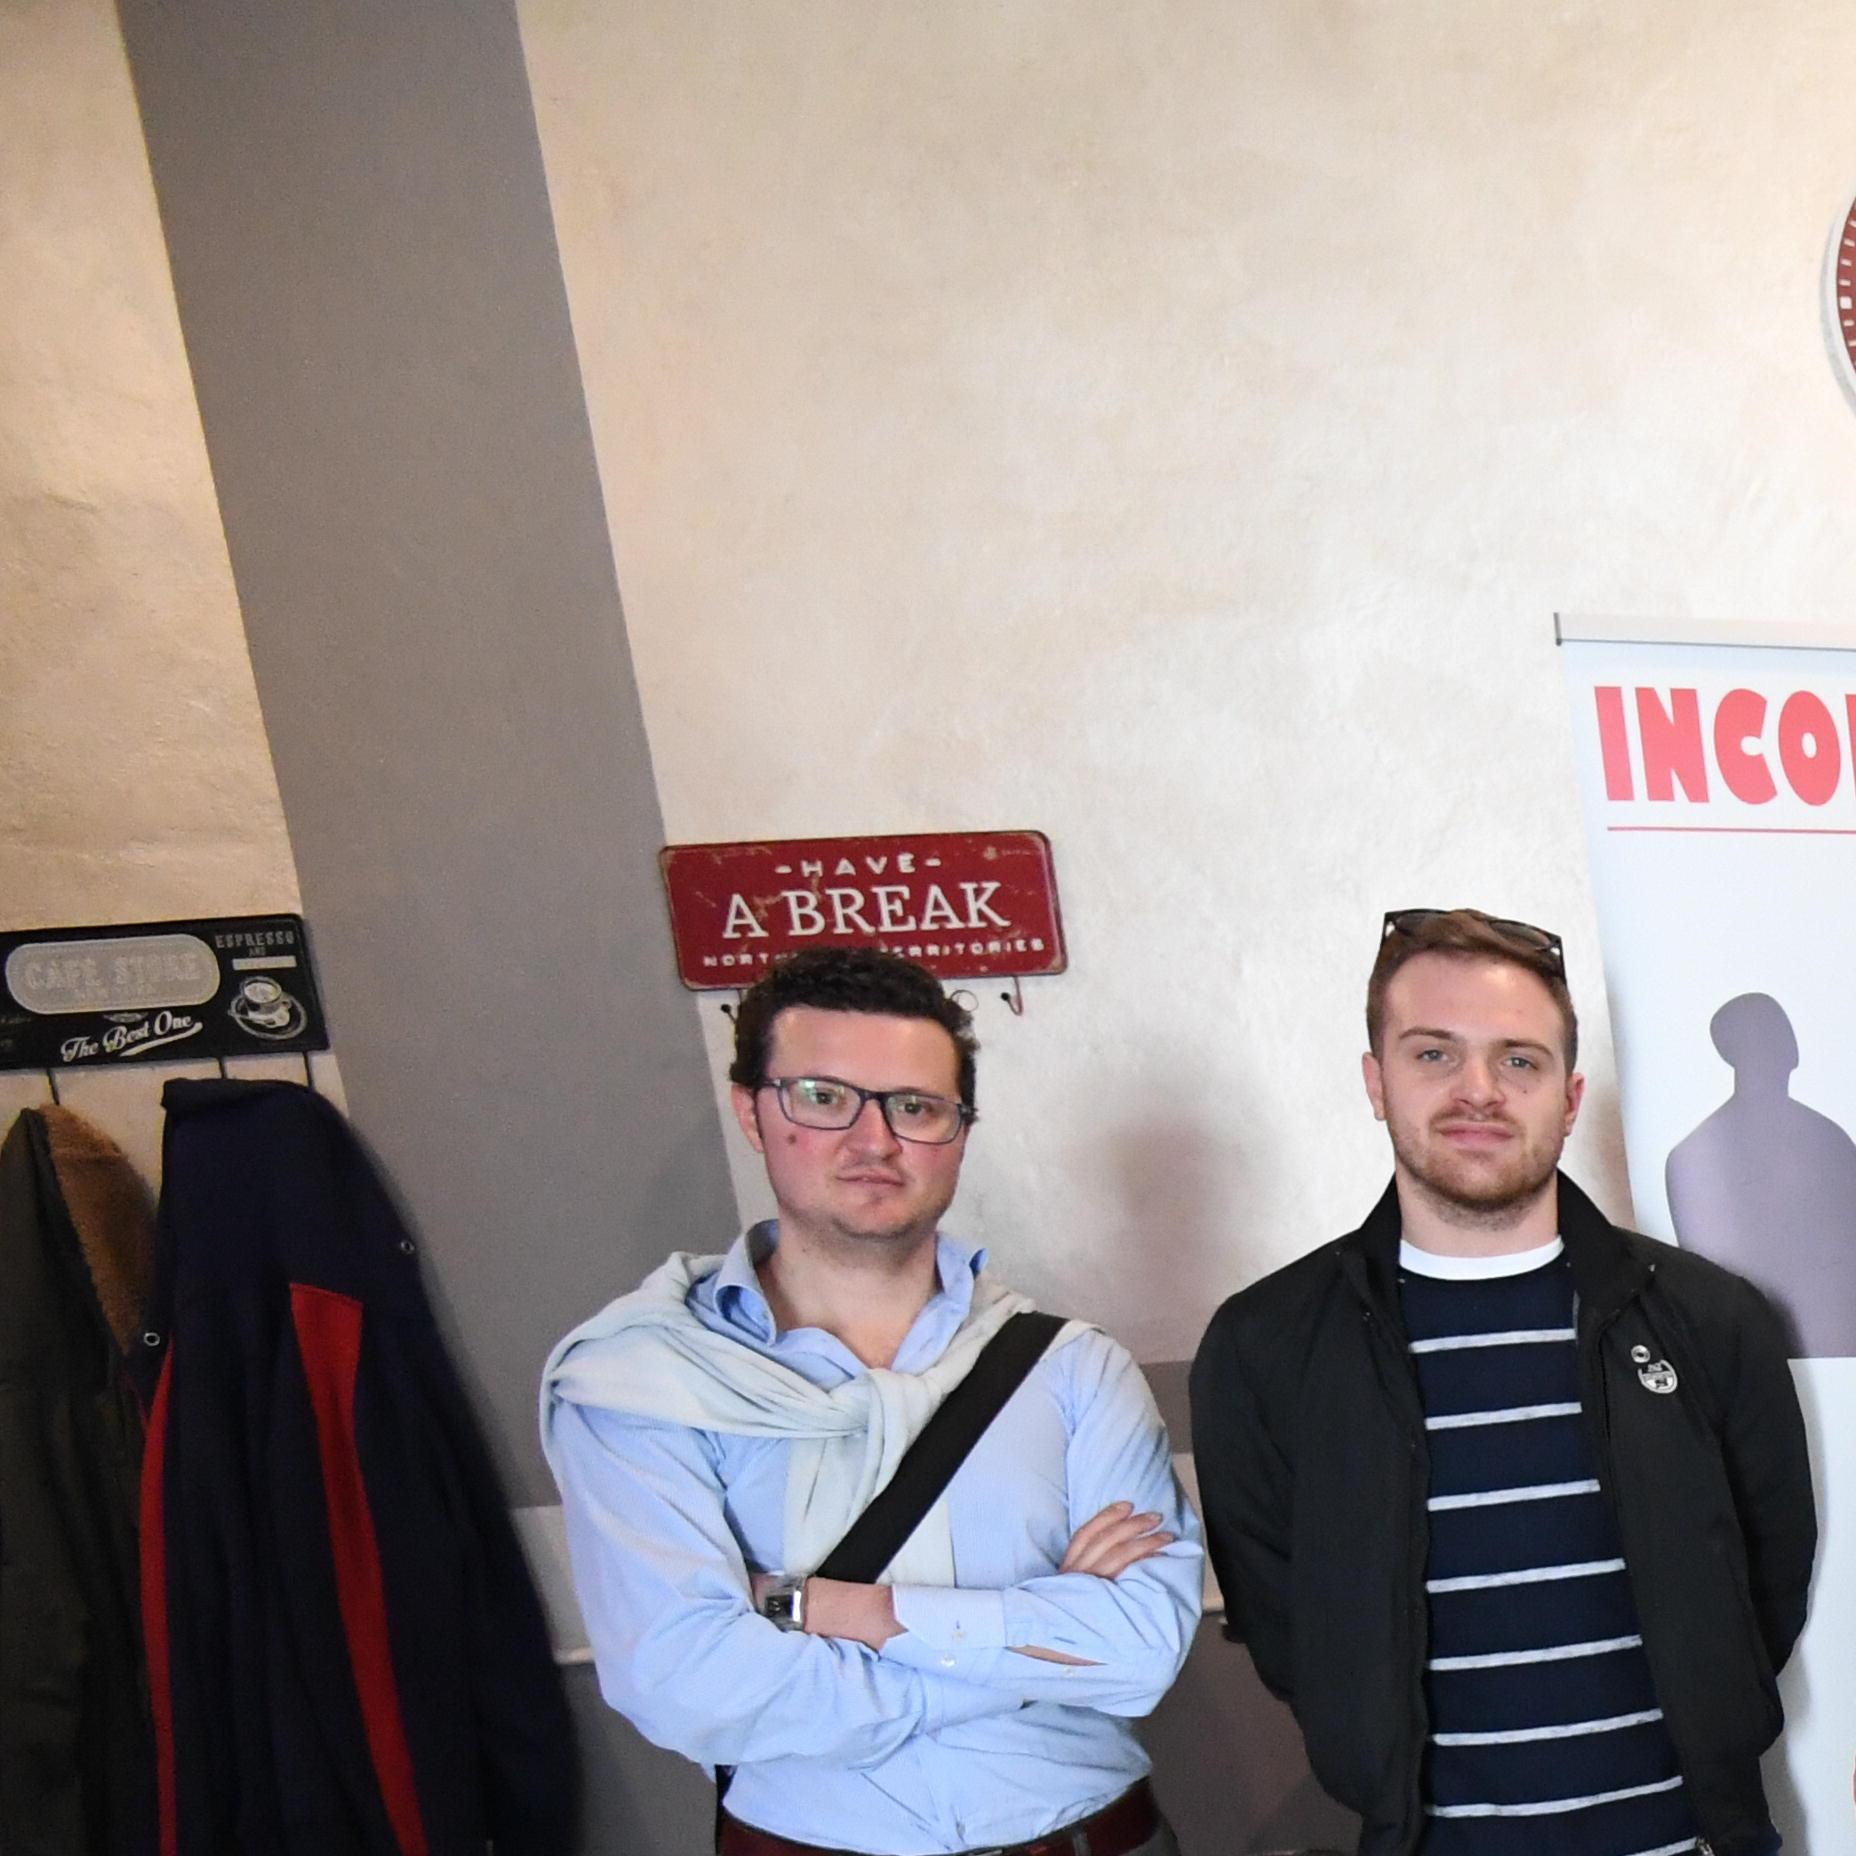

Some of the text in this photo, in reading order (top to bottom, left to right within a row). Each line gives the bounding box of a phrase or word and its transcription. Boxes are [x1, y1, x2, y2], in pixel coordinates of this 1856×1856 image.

[722, 881, 1012, 939] A BREAK
[214, 930, 295, 949] ESPRESSO
[60, 1011, 193, 1063] The Best One
